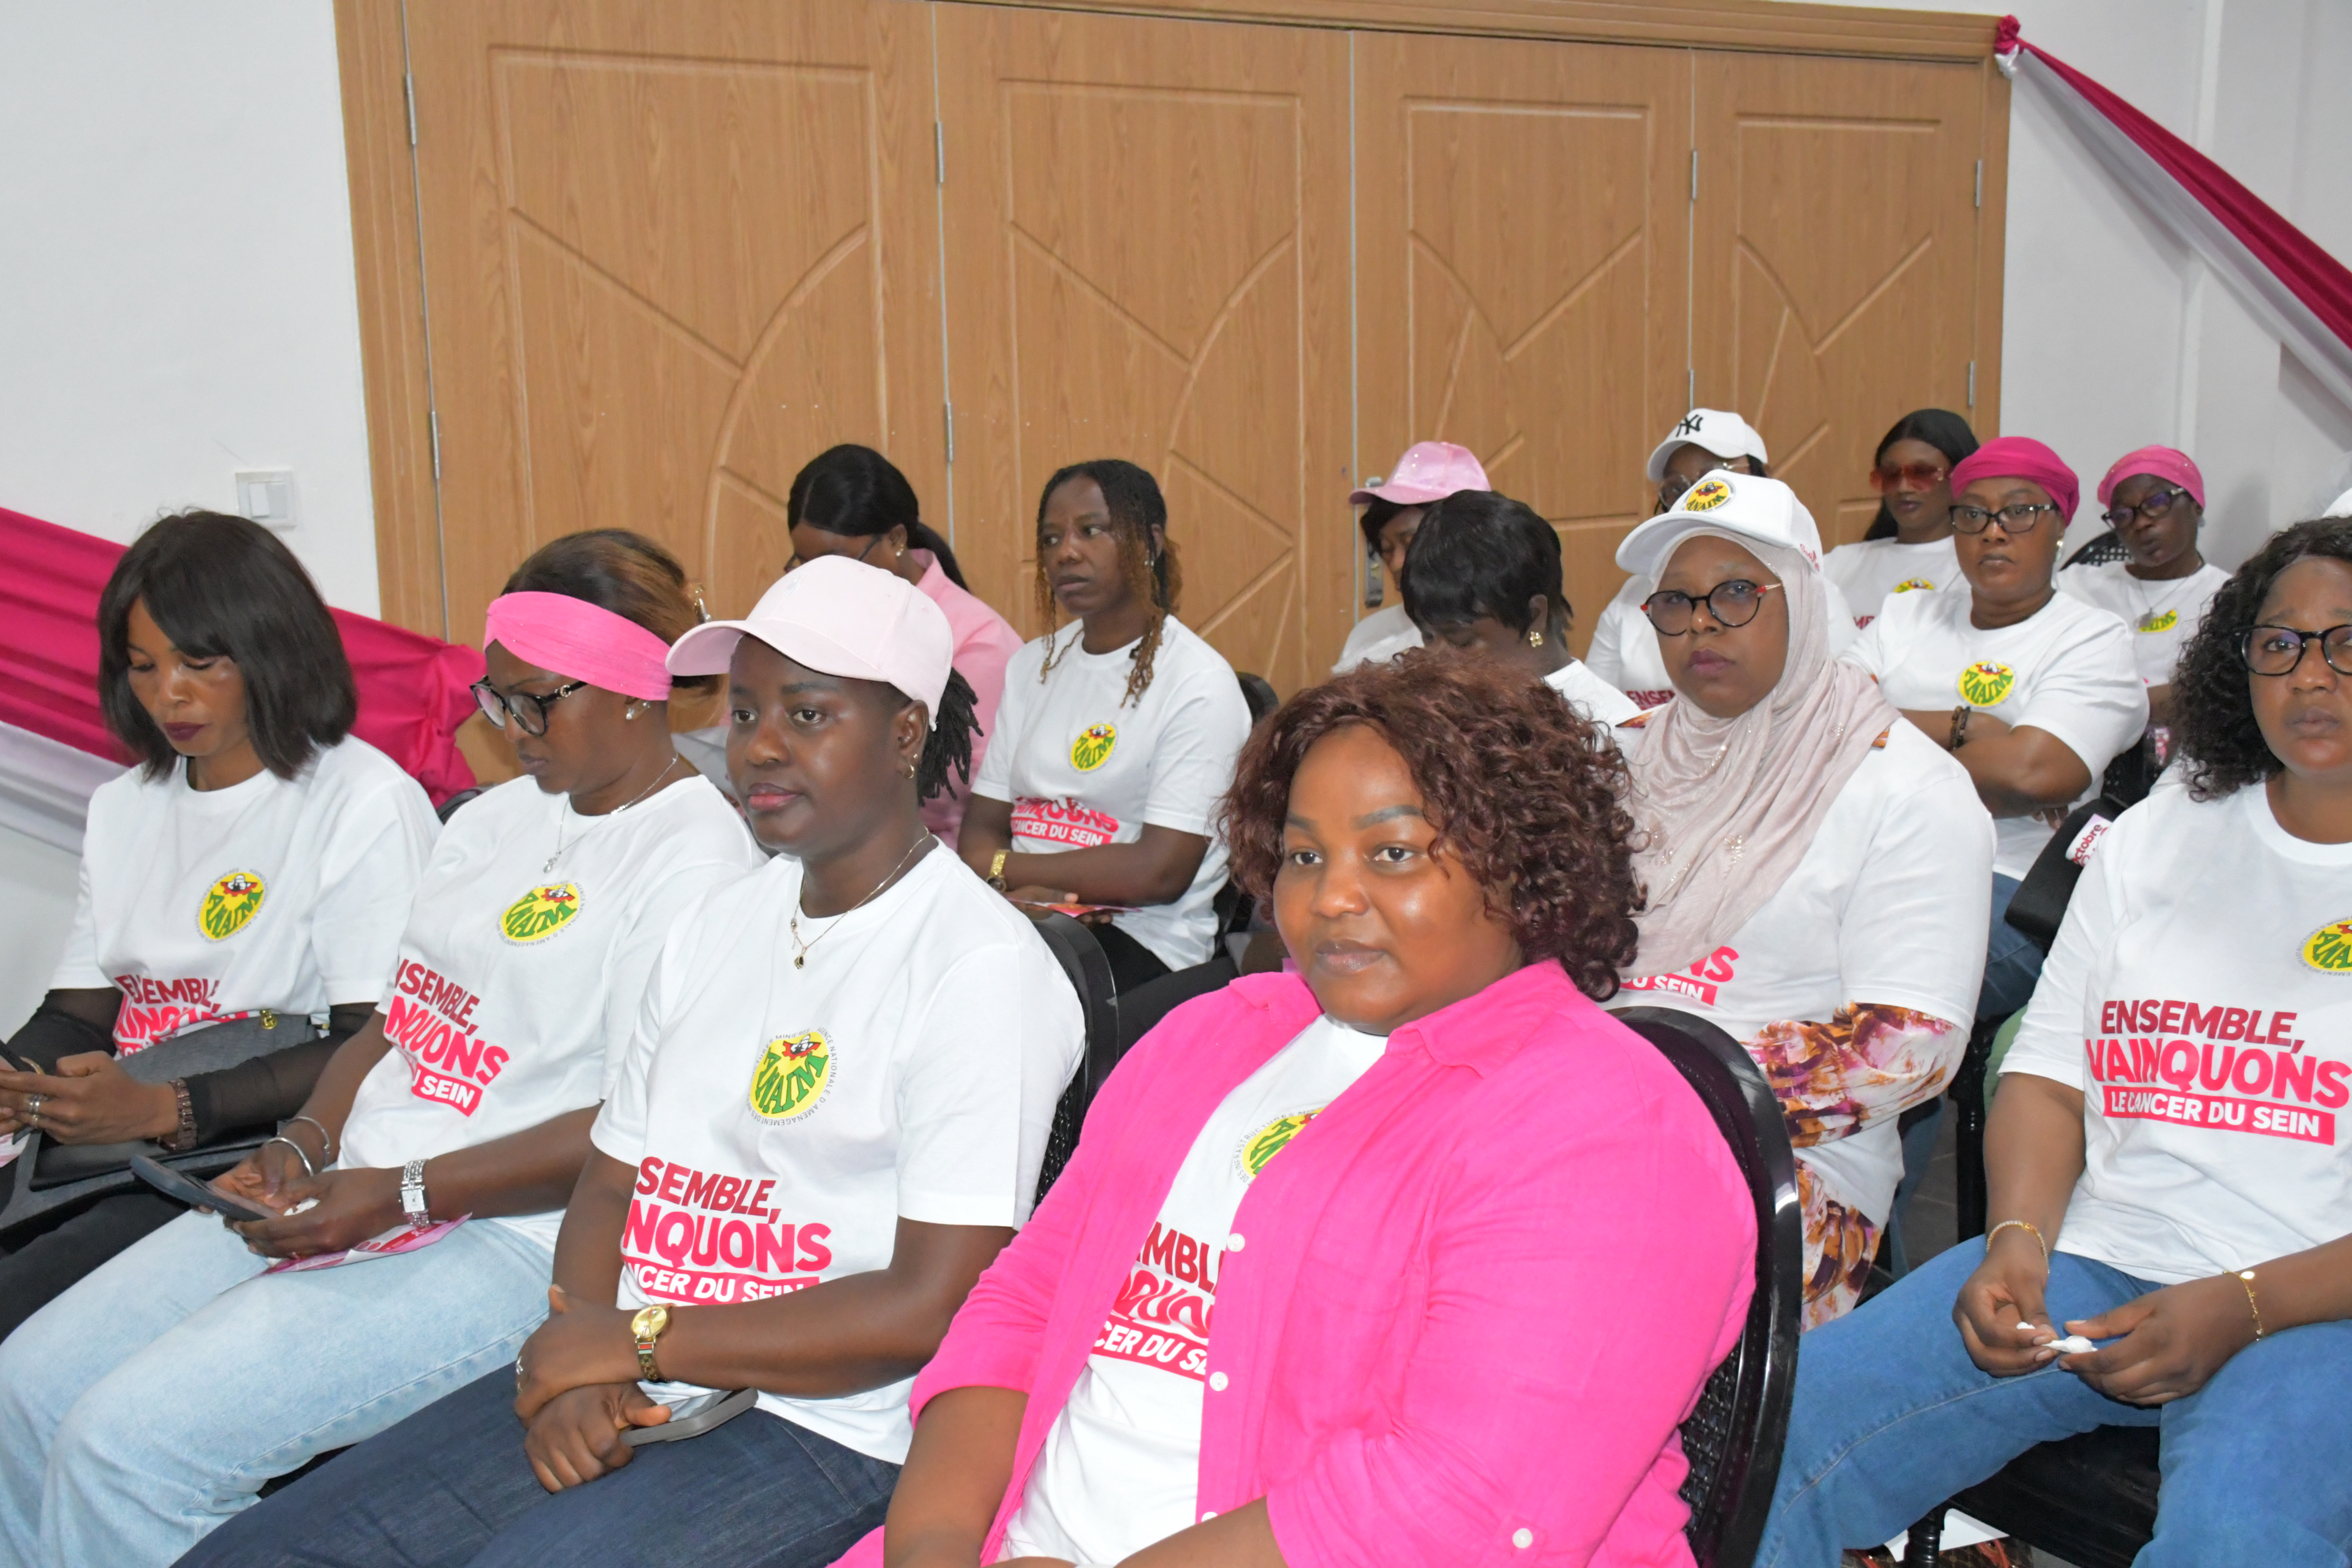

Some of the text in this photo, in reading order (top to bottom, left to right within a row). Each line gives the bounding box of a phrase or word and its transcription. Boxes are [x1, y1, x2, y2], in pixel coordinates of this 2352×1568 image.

[1964, 669, 2013, 704] ANAIM
[1075, 735, 1115, 769] ANAIM
[1049, 825, 1069, 839] DU
[1070, 829, 1103, 847] SEIN
[206, 889, 264, 937] ANAIM
[506, 890, 577, 937] ANAIM
[2312, 931, 2352, 969] ANA
[1653, 975, 1704, 1001] SEIN
[817, 1027, 834, 1045] AGENCE
[2101, 999, 2305, 1054] ENSEMBLE,
[755, 1047, 829, 1114] ANAIM
[823, 1046, 837, 1095] NATIONALE
[2085, 1038, 2352, 1109] VAINQUONS
[420, 1075, 475, 1108] SEIN
[751, 1111, 761, 1122] DES
[2111, 1091, 2319, 1137] LE CANCER DU SEIN
[636, 1156, 781, 1224] SEMBLE,
[1237, 1170, 1249, 1183] DES
[623, 1199, 832, 1273] NQUONS
[1136, 1221, 1225, 1297] MBL
[694, 1277, 735, 1302] DU
[1137, 1334, 1186, 1363] DU
